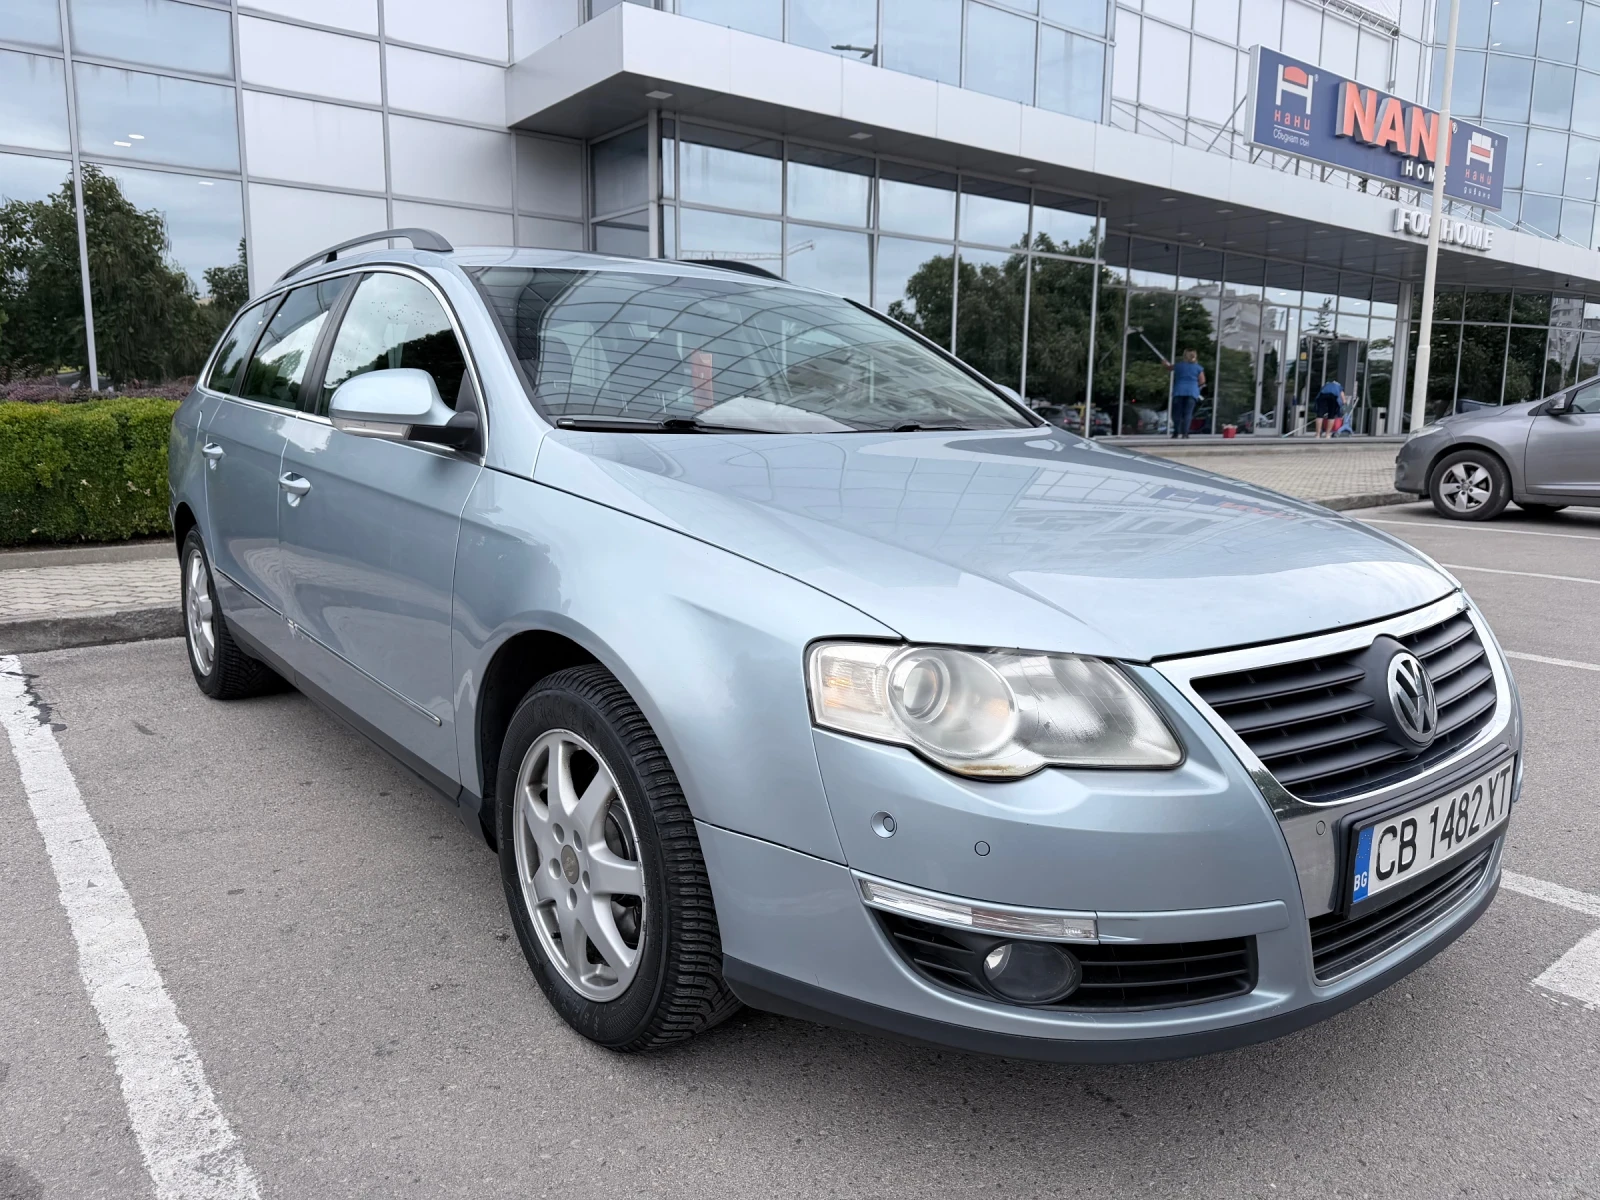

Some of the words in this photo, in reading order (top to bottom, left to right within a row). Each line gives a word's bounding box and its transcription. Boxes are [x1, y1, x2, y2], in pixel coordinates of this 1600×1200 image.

[1403, 159, 1447, 187] HOM
[1440, 217, 1494, 250] HOME
[1375, 816, 1418, 881] CB
[1429, 784, 1483, 860] 1482
[1483, 763, 1511, 828] XT
[1353, 870, 1369, 893] BG
